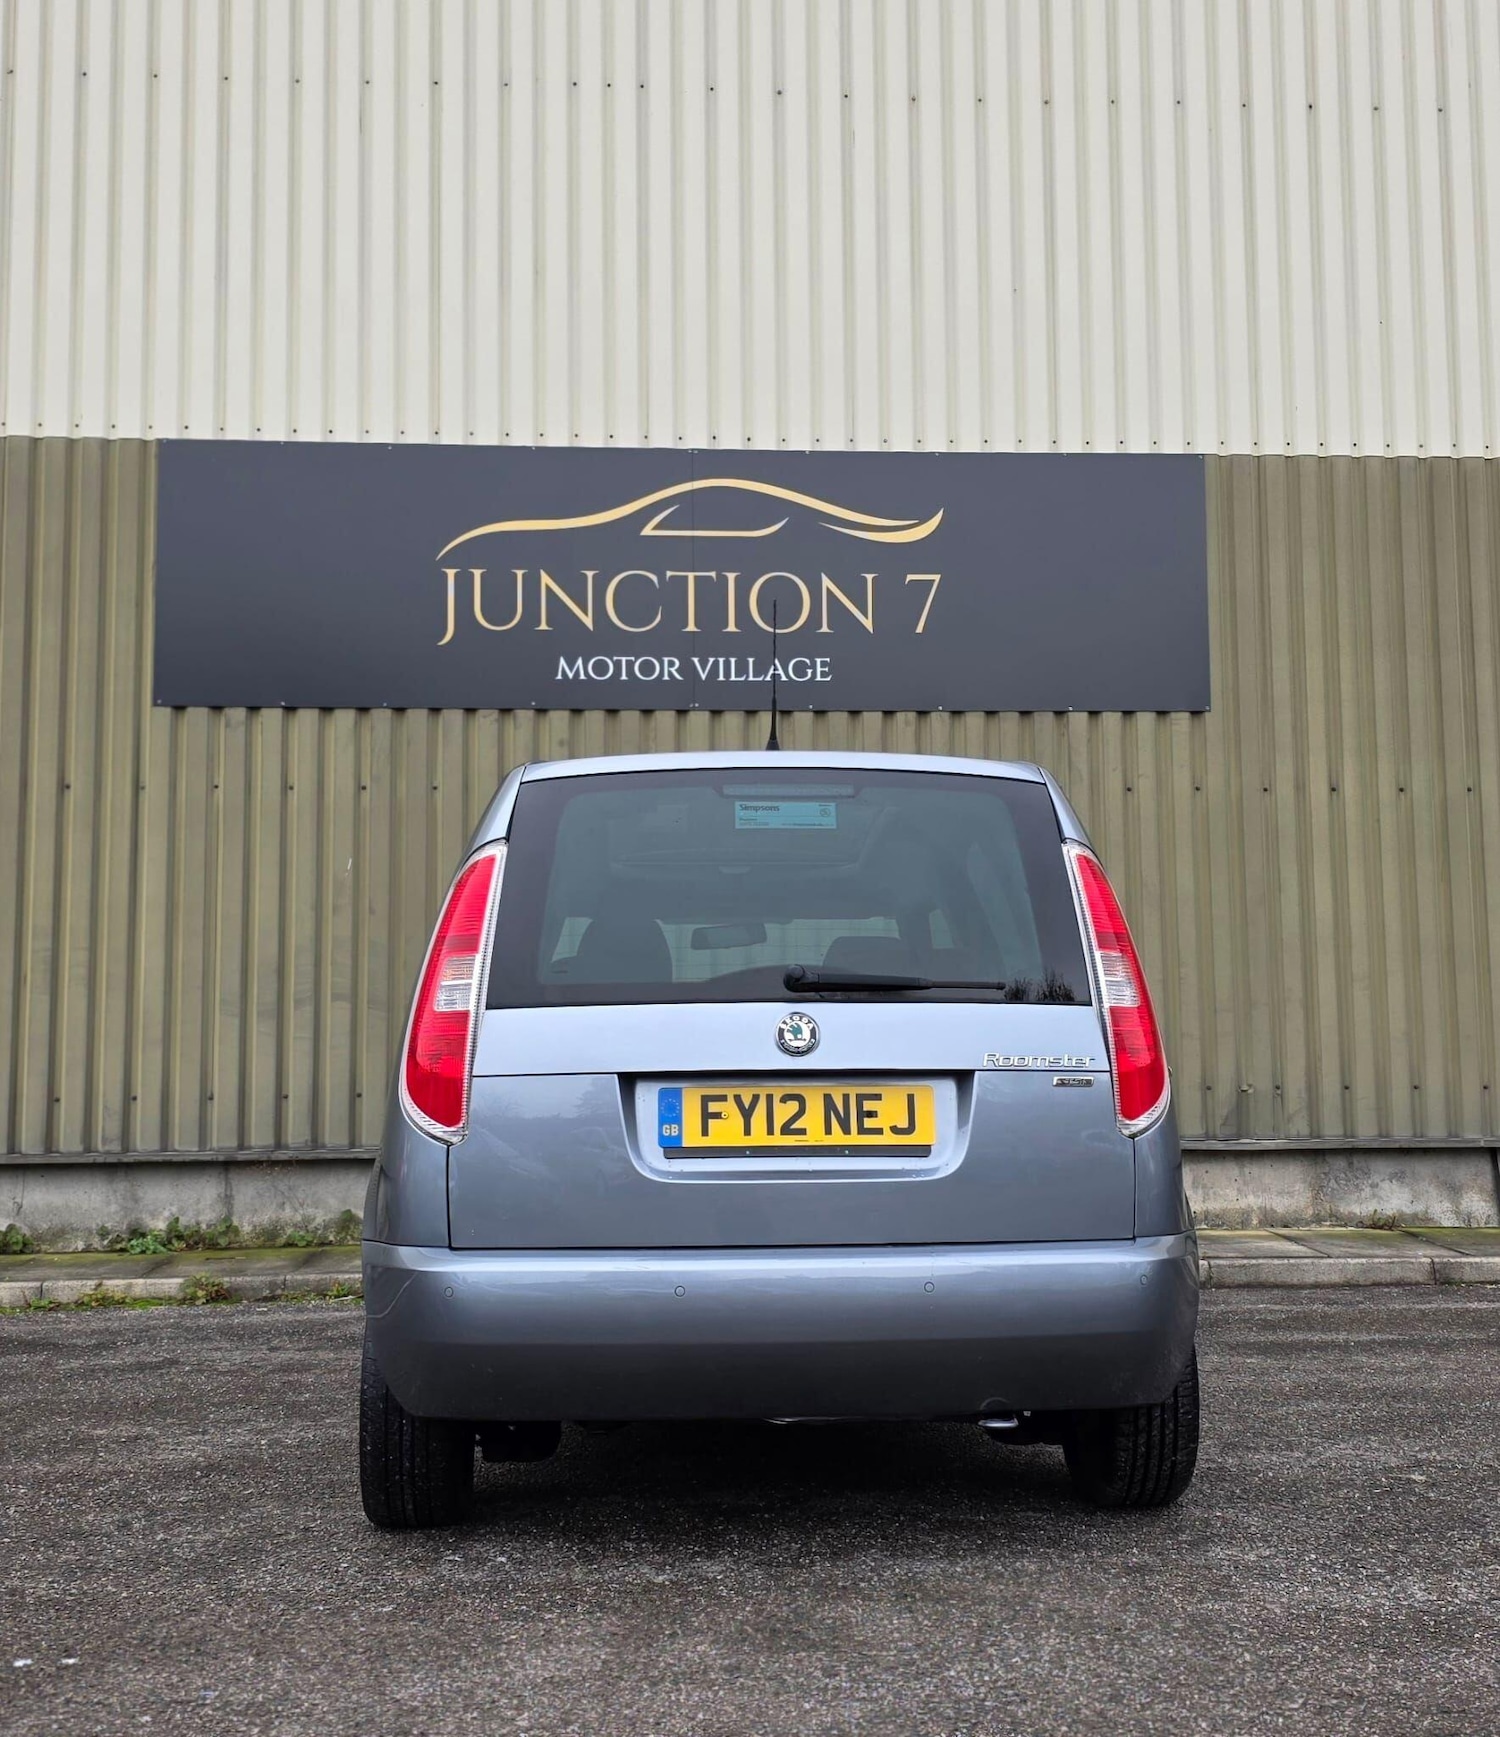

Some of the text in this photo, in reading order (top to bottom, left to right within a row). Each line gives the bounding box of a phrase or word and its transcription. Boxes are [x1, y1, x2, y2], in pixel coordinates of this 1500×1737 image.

[436, 568, 943, 646] JUNCTION 7
[555, 655, 833, 682] MOTOR VILLAGE
[739, 803, 780, 813] Simpsons
[982, 1052, 1097, 1068] Roomster
[700, 1093, 917, 1137] FY12 NEJ
[662, 1124, 679, 1136] GB
